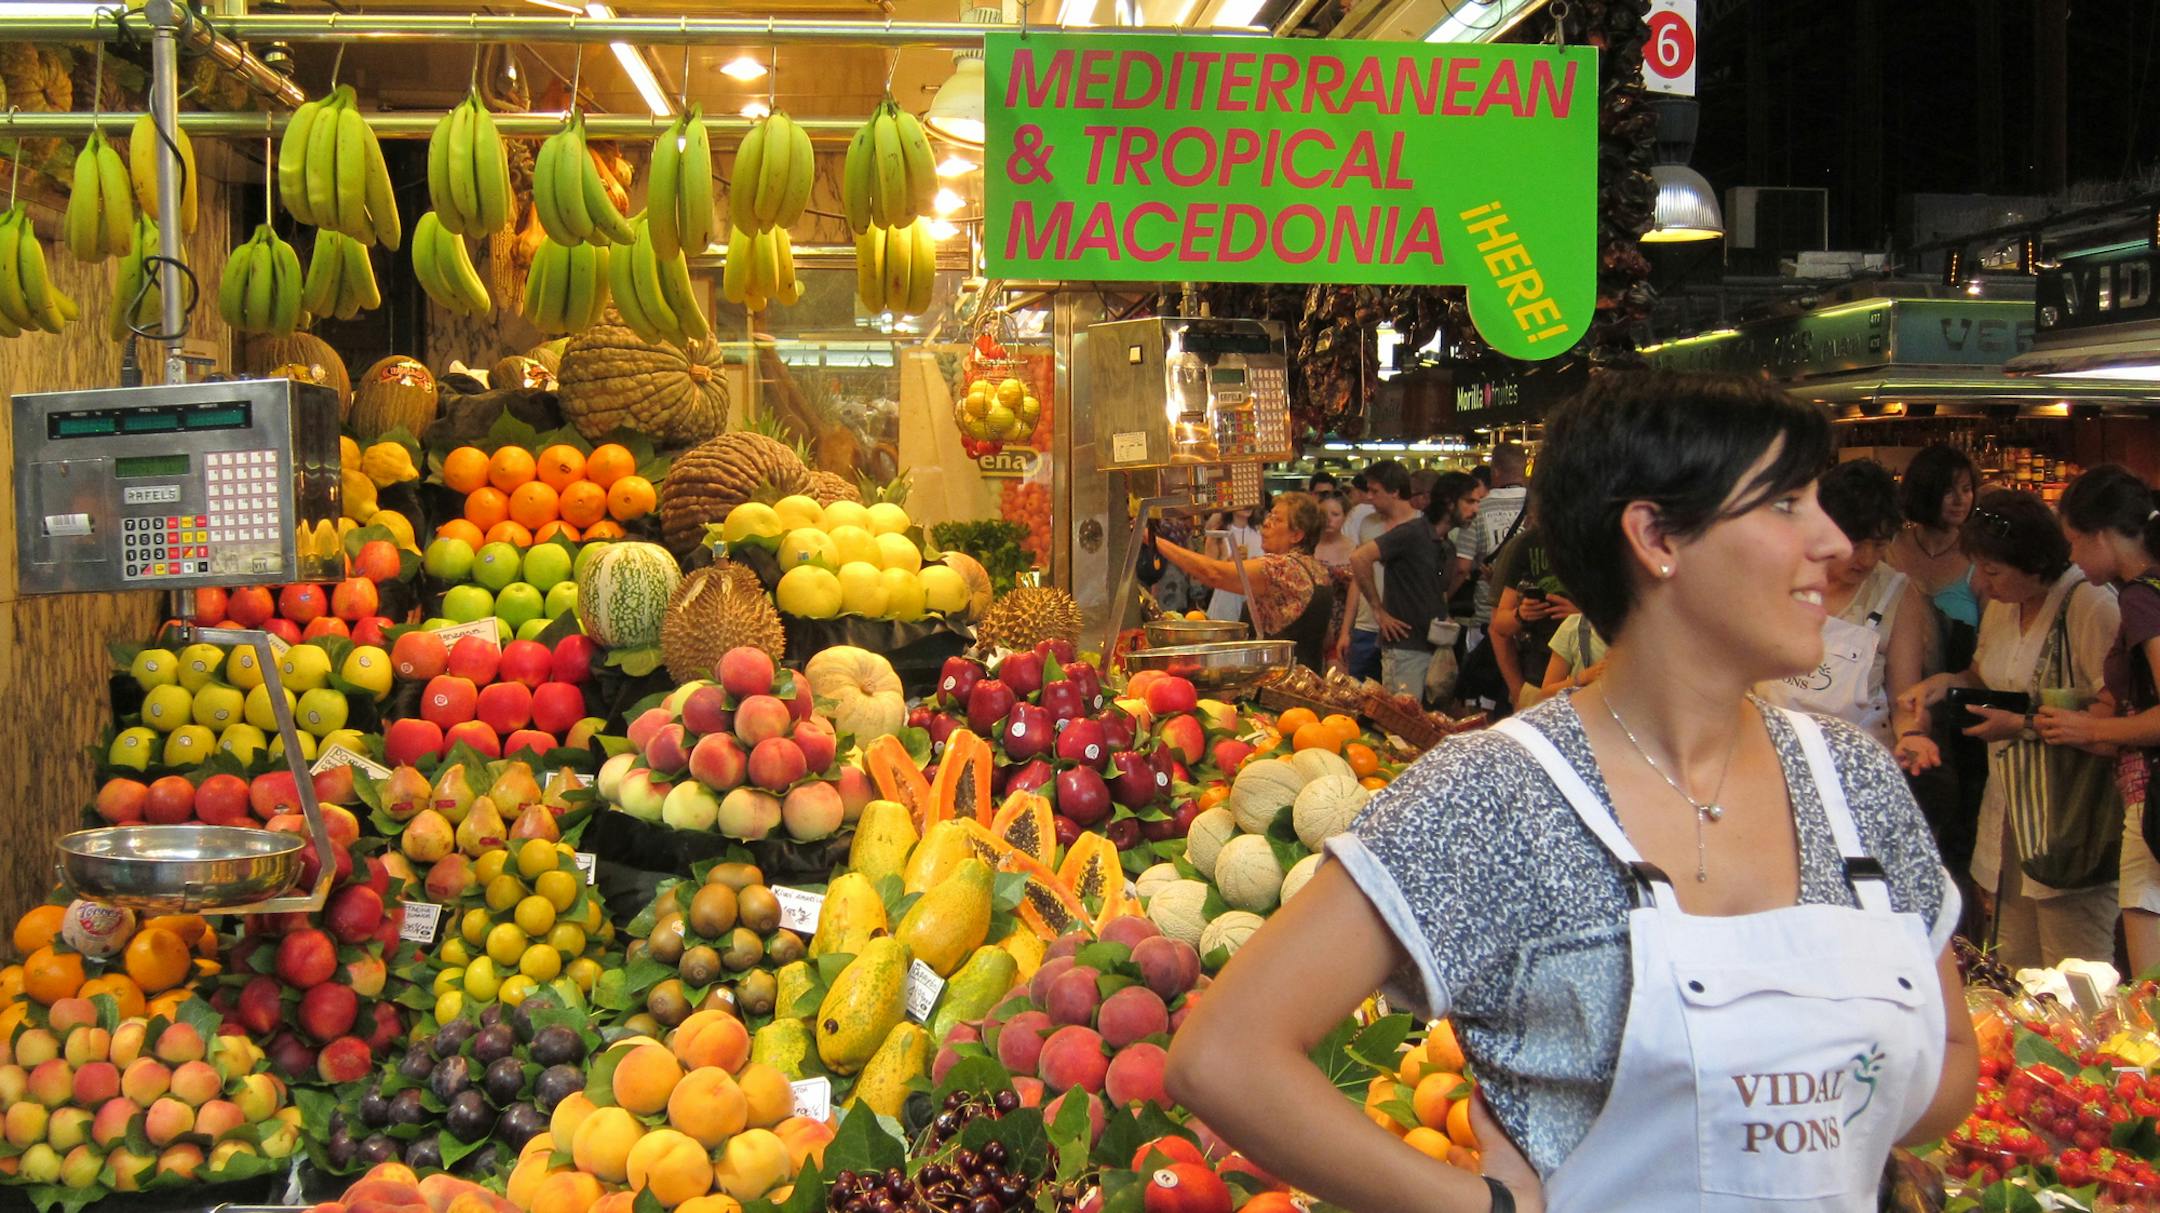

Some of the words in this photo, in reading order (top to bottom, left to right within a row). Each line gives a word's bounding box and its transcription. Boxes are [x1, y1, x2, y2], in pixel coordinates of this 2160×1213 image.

[1658, 23, 1679, 67] 6
[1005, 49, 1577, 118] MEDITERRANEAN
[1007, 124, 1053, 185] &
[1085, 126, 1413, 190] TROPICAL
[1005, 201, 1444, 265] MACEDONIA
[1731, 1070, 1844, 1108] VIDAL
[1741, 1117, 1840, 1155] PONS
